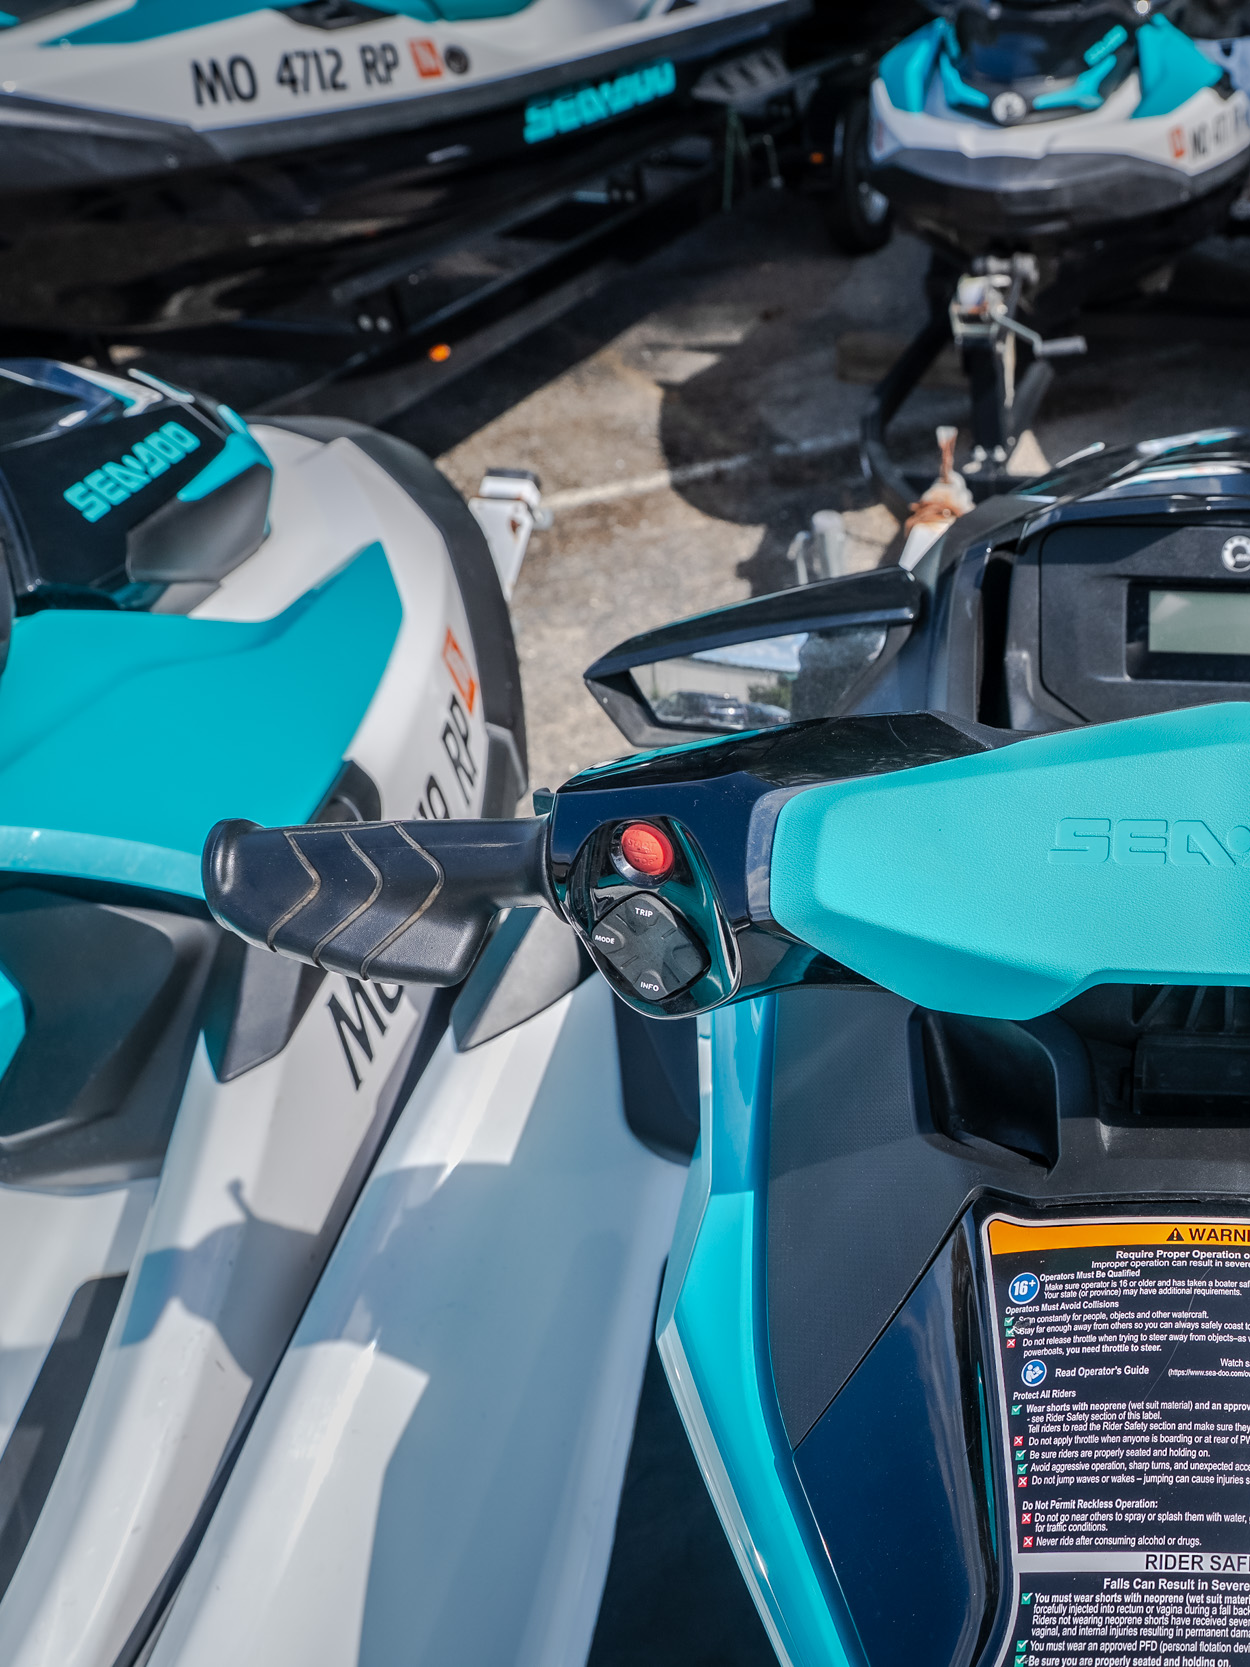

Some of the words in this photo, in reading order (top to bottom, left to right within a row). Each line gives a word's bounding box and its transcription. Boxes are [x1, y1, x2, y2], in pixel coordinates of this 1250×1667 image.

[190, 54, 258, 106] MO
[276, 48, 348, 95] 4712
[359, 43, 400, 86] RP
[441, 694, 477, 806] RP
[635, 907, 653, 918] TRIP
[594, 934, 615, 945] MODE
[640, 981, 659, 992] INFO
[1116, 1250, 1154, 1262] Require
[1155, 1250, 1190, 1261] Proper
[1192, 1250, 1241, 1261] Operation
[1091, 1261, 1128, 1270] Improper
[1130, 1259, 1170, 1268] operation
[1189, 1258, 1213, 1267] result
[1214, 1259, 1223, 1267] in
[1039, 1273, 1075, 1284] Operators
[1076, 1271, 1094, 1279] Must
[1096, 1270, 1106, 1278] Be
[1107, 1269, 1140, 1278] Qualified
[1013, 1279, 1036, 1296] 16+
[1005, 1305, 1040, 1315] Operators
[1041, 1303, 1059, 1311] Must
[1060, 1301, 1081, 1310] Avoid
[1082, 1300, 1119, 1309] Collisions
[1024, 1347, 1064, 1358] powerboats,
[1066, 1347, 1080, 1356] you
[1082, 1344, 1101, 1353] need
[1102, 1344, 1129, 1352] throttle
[1131, 1344, 1139, 1352] to
[1140, 1344, 1162, 1352] steer.
[1220, 1358, 1244, 1367] Watch
[1055, 1367, 1076, 1377] Read
[1078, 1366, 1122, 1378] Operator's
[1124, 1365, 1149, 1375] Guide
[1013, 1391, 1039, 1400] Protect
[1040, 1390, 1050, 1398] All
[1052, 1389, 1076, 1398] Riders
[1026, 1404, 1046, 1413] Wear
[1046, 1403, 1070, 1412] shorts
[1072, 1402, 1088, 1411] with
[1090, 1403, 1126, 1412] neoprene
[1128, 1401, 1144, 1412] (wet
[1145, 1400, 1159, 1409] suit
[1160, 1400, 1193, 1411] material)
[1194, 1401, 1210, 1410] and
[1028, 1437, 1039, 1446] Do
[1040, 1436, 1052, 1445] not
[1053, 1436, 1073, 1446] apply
[1074, 1435, 1099, 1444] throttle
[1101, 1434, 1121, 1443] when
[1122, 1436, 1150, 1445] anyone
[1151, 1434, 1158, 1443] is
[1160, 1434, 1193, 1445] boarding
[1204, 1435, 1212, 1443] at
[1213, 1436, 1229, 1444] rear
[1230, 1435, 1239, 1444] of
[1030, 1450, 1040, 1459] Be
[1058, 1449, 1079, 1458] riders
[1094, 1448, 1124, 1459] properly
[1126, 1448, 1151, 1457] seated
[1153, 1448, 1168, 1457] and
[1169, 1448, 1197, 1459] holding
[1022, 1501, 1034, 1510] Do
[1035, 1500, 1049, 1510] Not
[1050, 1500, 1076, 1509] Permit
[1077, 1499, 1113, 1509] Reckless
[1115, 1499, 1158, 1510] Operation:
[1035, 1523, 1046, 1532] for
[1046, 1523, 1067, 1532] traffic
[1068, 1522, 1108, 1532] conditions.
[1036, 1537, 1058, 1546] Never
[1059, 1536, 1074, 1546] ride
[1075, 1536, 1093, 1545] after
[1094, 1536, 1136, 1547] consuming
[1138, 1535, 1166, 1545] alcohol
[1177, 1536, 1202, 1548] drugs.
[1145, 1554, 1203, 1571] RIDER
[1103, 1578, 1130, 1589] Falls
[1133, 1578, 1155, 1590] Can
[1158, 1578, 1195, 1590] Result
[1198, 1579, 1208, 1590] in
[1212, 1580, 1250, 1591] Severe
[1035, 1594, 1050, 1603] You
[1051, 1593, 1072, 1603] must
[1095, 1593, 1122, 1603] shorts
[1124, 1593, 1142, 1603] with
[1144, 1596, 1184, 1606] neoprene
[1186, 1594, 1204, 1606] (wet
[1206, 1595, 1222, 1604] suit
[1030, 1641, 1044, 1651] You
[1046, 1641, 1065, 1651] must
[1066, 1643, 1086, 1651] wear
[1087, 1643, 1098, 1651] an
[1100, 1641, 1137, 1653] approved
[1139, 1641, 1158, 1651] PFD
[1159, 1642, 1197, 1653] (personal
[1199, 1642, 1231, 1652] flotation
[1028, 1656, 1040, 1666] Be
[1061, 1659, 1077, 1667] you
[1094, 1656, 1131, 1667] properly
[1133, 1656, 1162, 1666] seated
[1164, 1656, 1180, 1666] and
[1182, 1656, 1215, 1667] holding
[1217, 1659, 1231, 1667] on.
